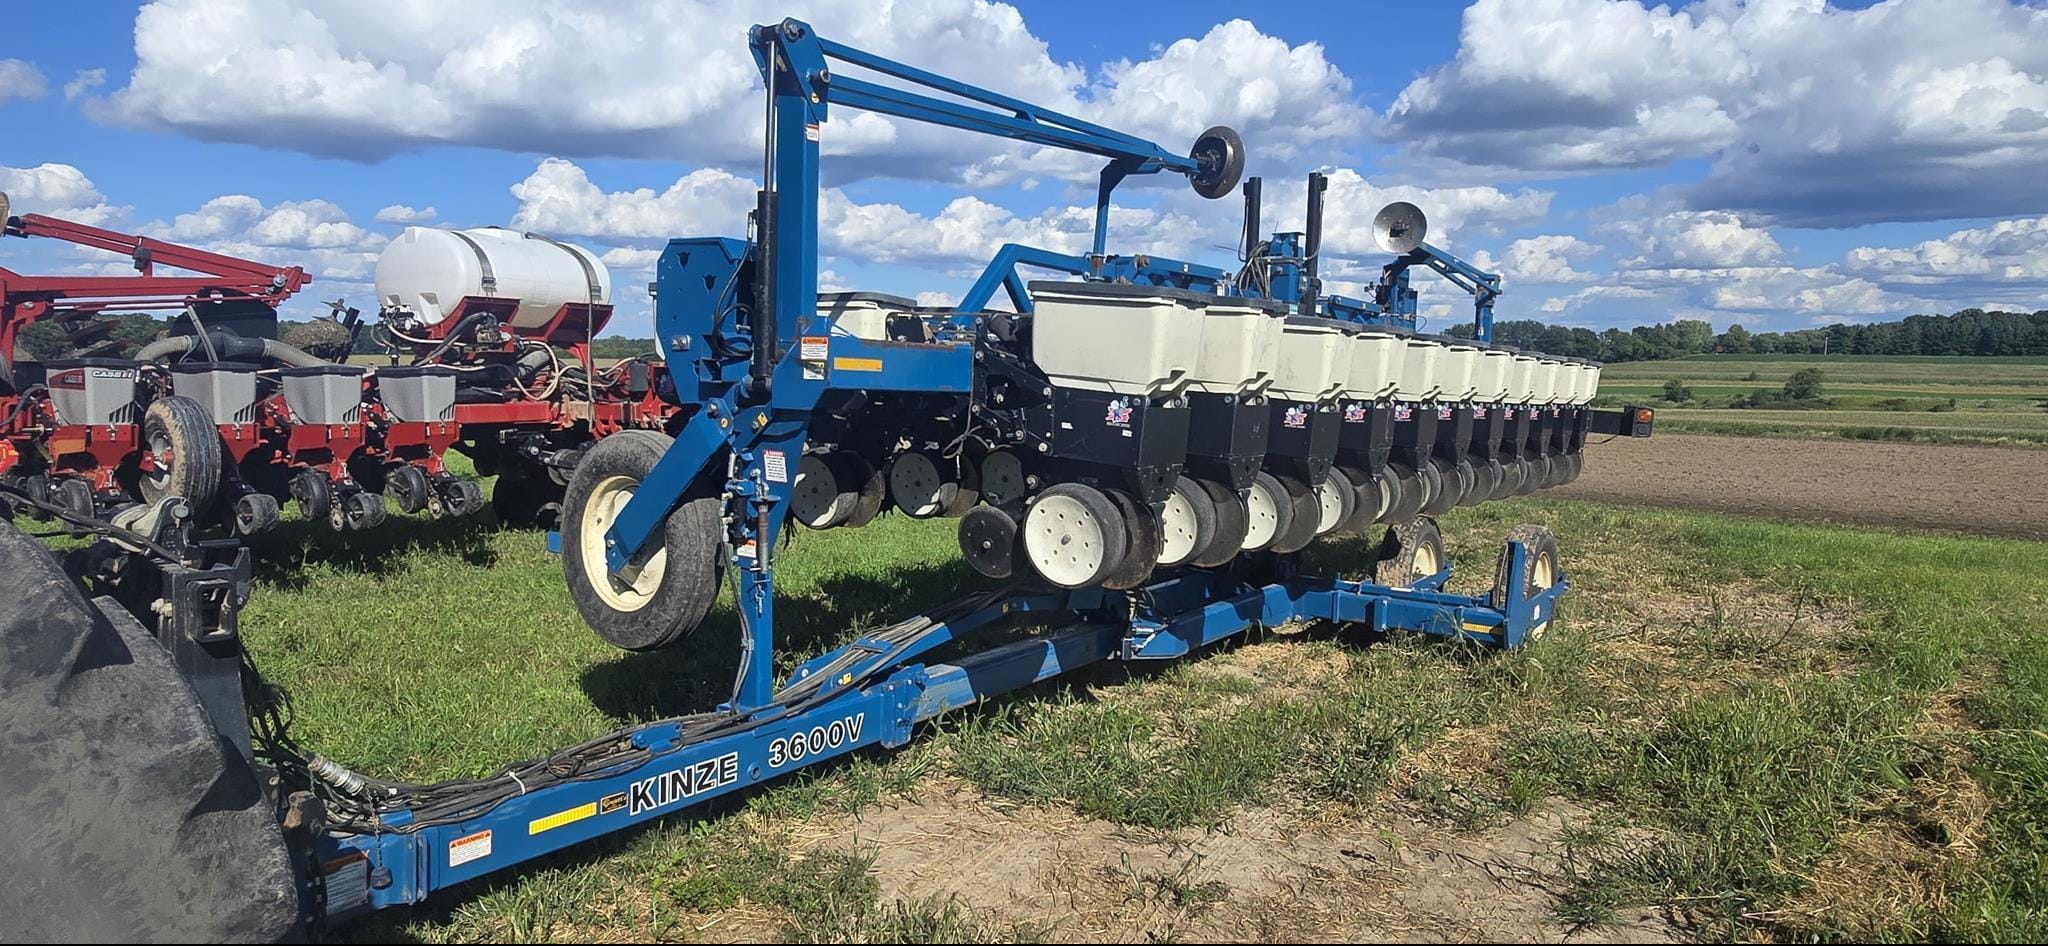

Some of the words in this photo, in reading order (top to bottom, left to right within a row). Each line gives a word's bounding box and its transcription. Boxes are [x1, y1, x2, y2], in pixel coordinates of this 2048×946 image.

[630, 751, 739, 816] KINZE
[768, 712, 865, 768] 3600V
[456, 833, 484, 847] WARNING
